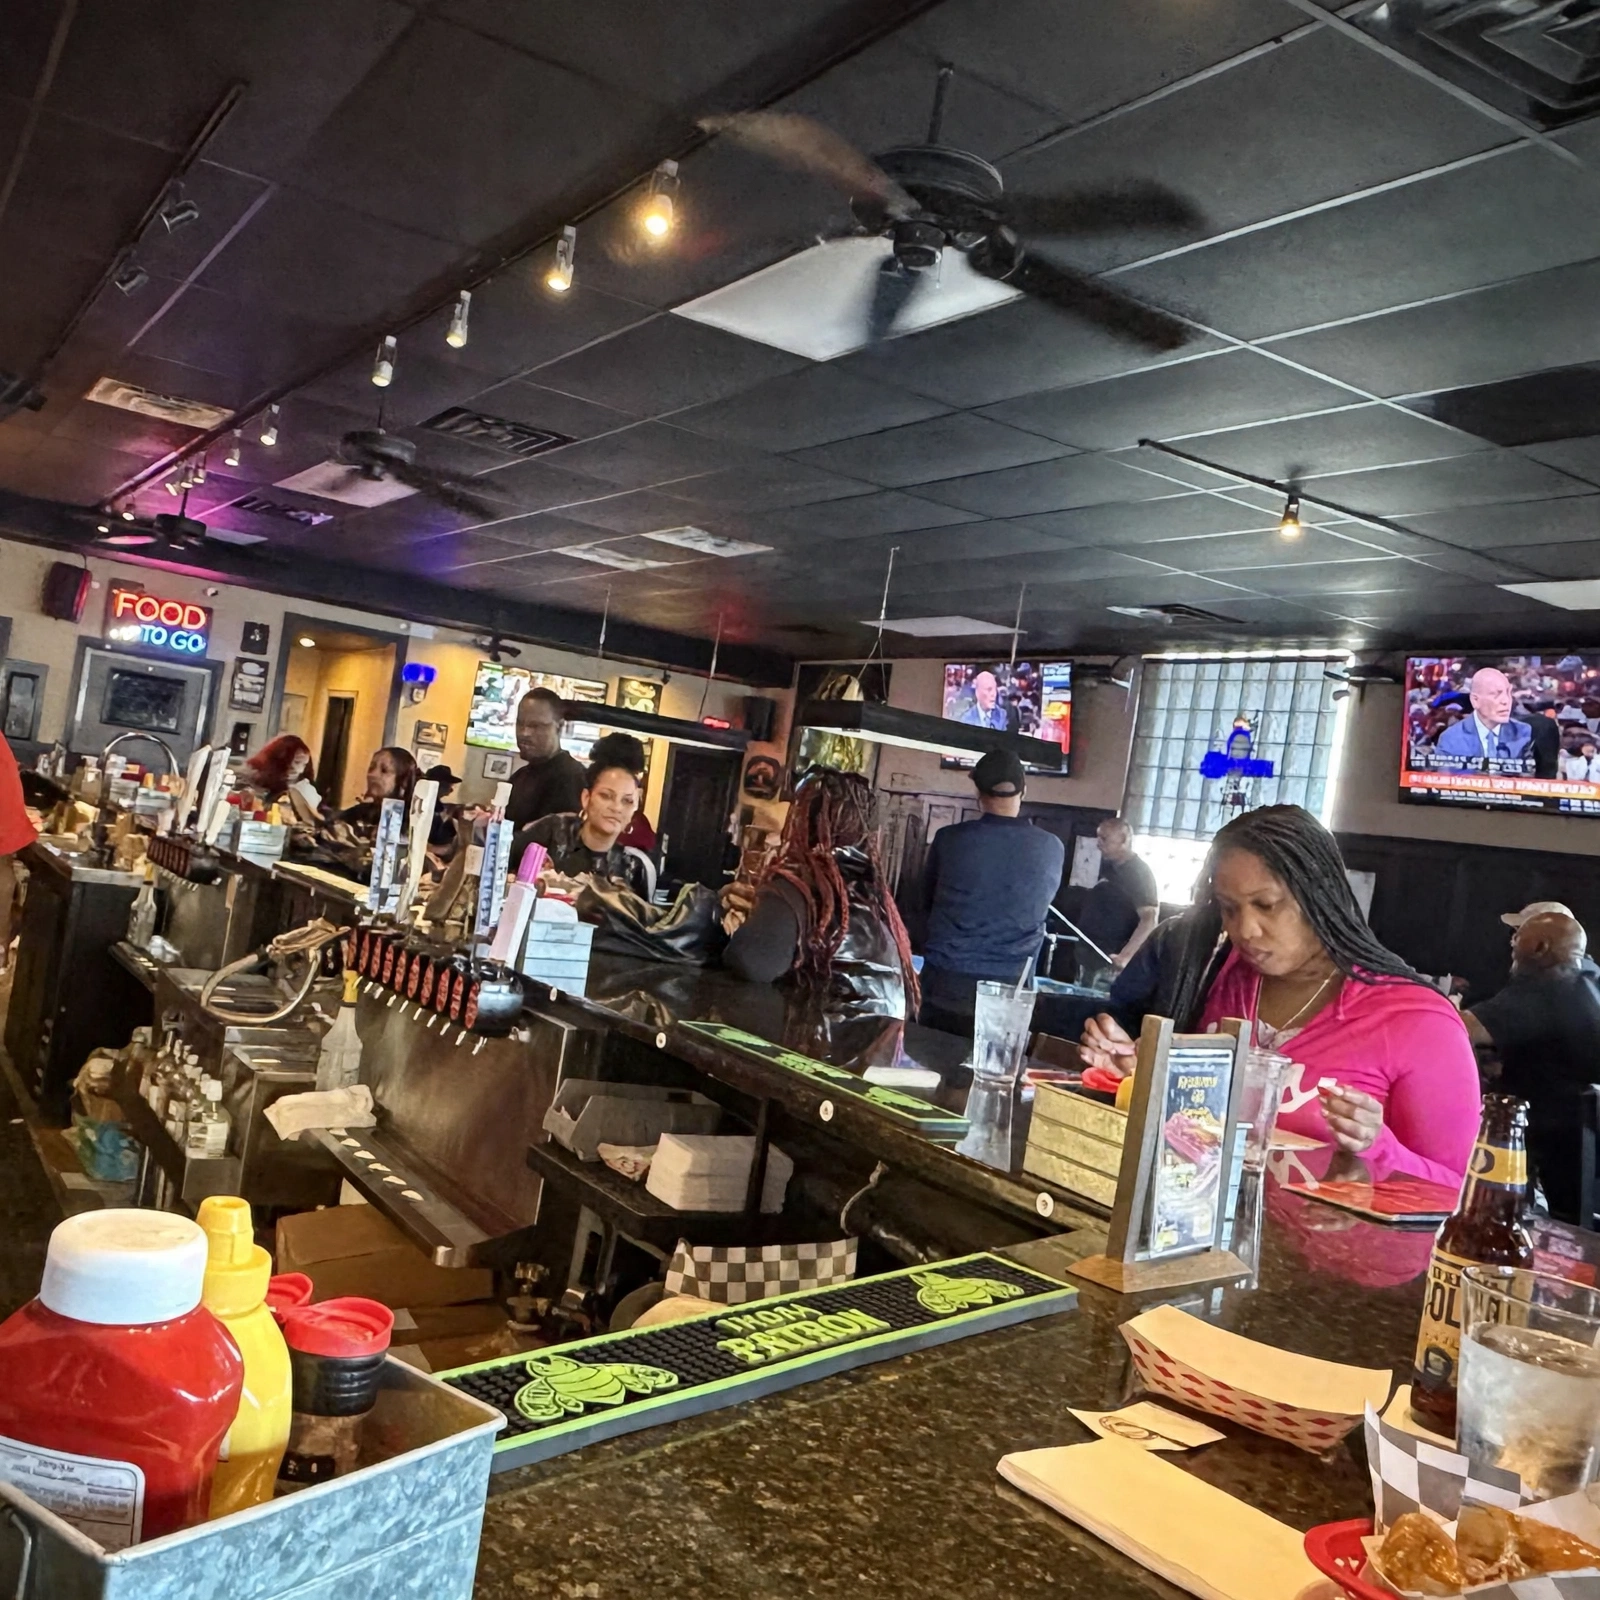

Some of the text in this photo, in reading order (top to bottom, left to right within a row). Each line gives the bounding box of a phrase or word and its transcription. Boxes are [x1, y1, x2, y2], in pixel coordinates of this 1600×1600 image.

[115, 592, 206, 630] FOOD
[140, 624, 206, 653] TO GO
